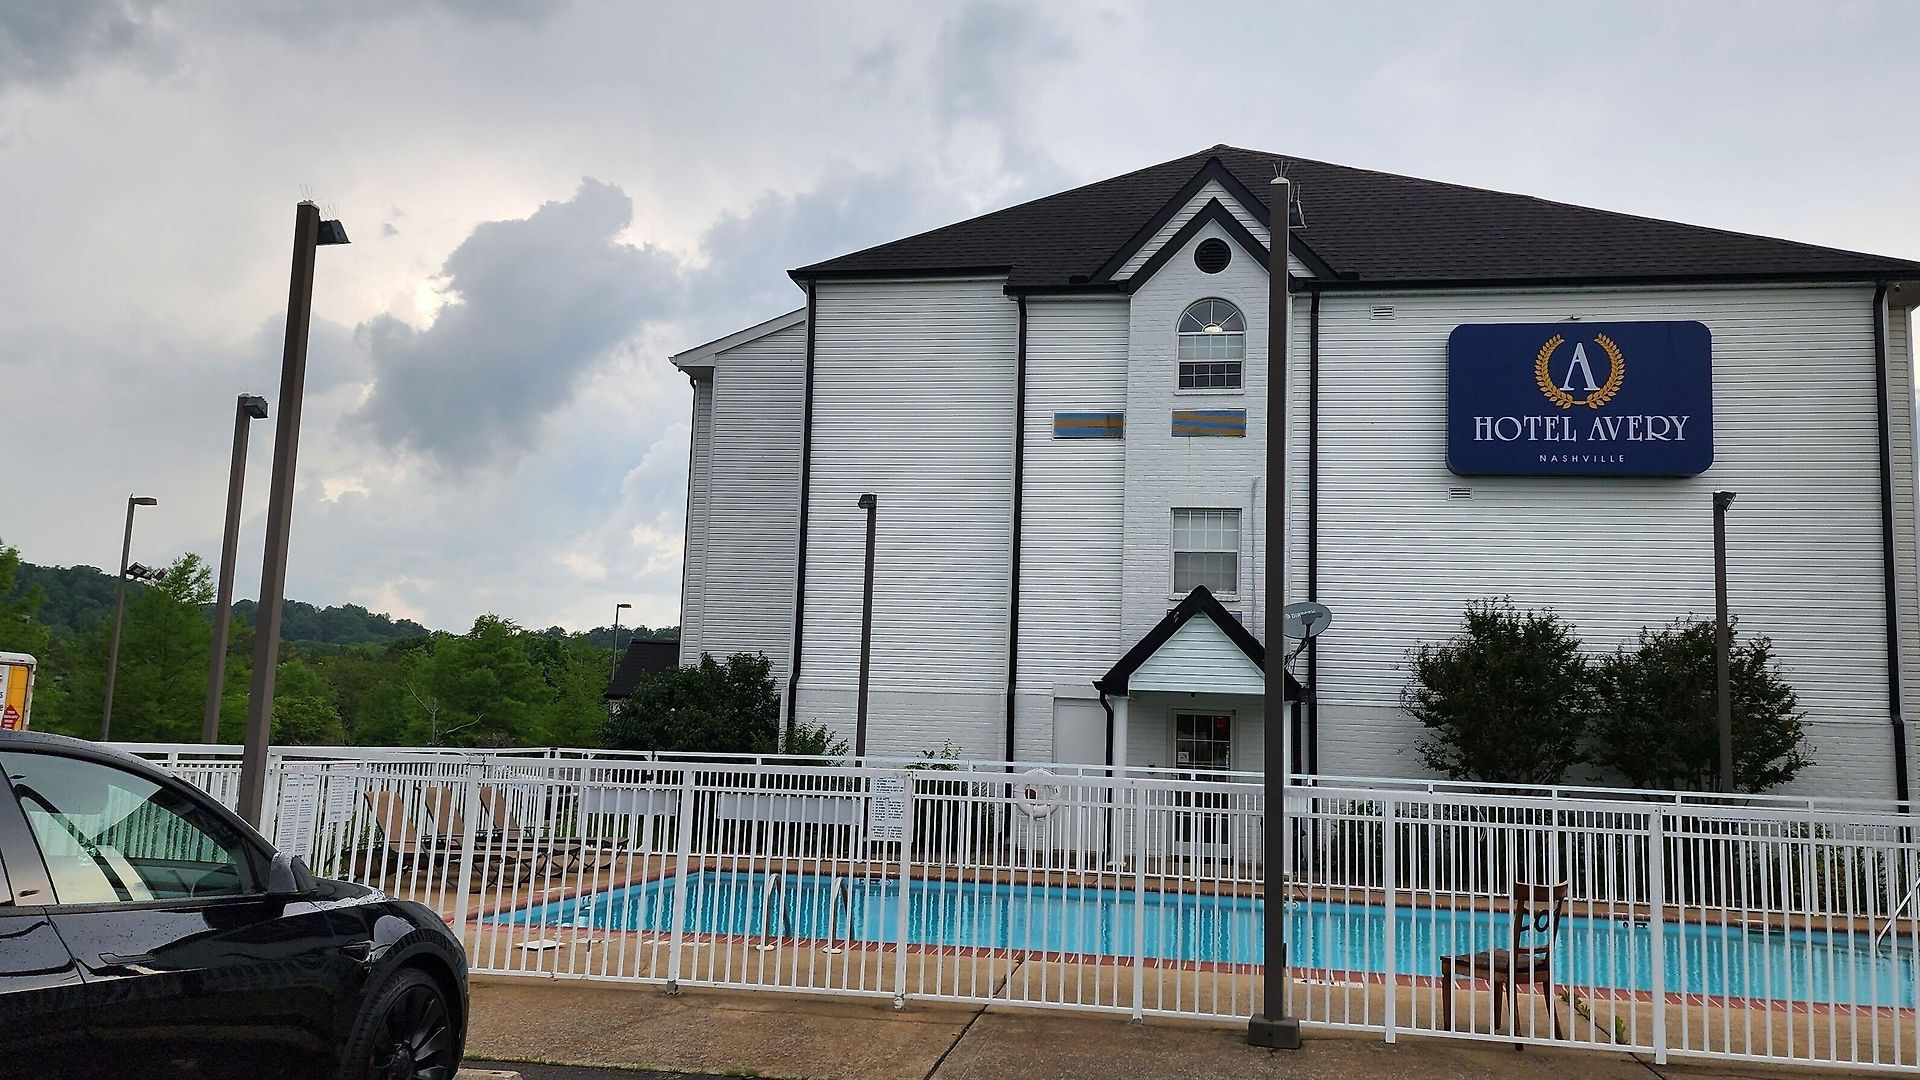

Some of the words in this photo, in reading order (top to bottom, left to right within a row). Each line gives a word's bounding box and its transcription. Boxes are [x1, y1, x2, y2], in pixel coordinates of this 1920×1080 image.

[1560, 342, 1600, 391] A
[1474, 415, 1577, 442] HOTEL
[1587, 415, 1690, 442] AVERY
[1540, 454, 1625, 463] NASHVILLE
